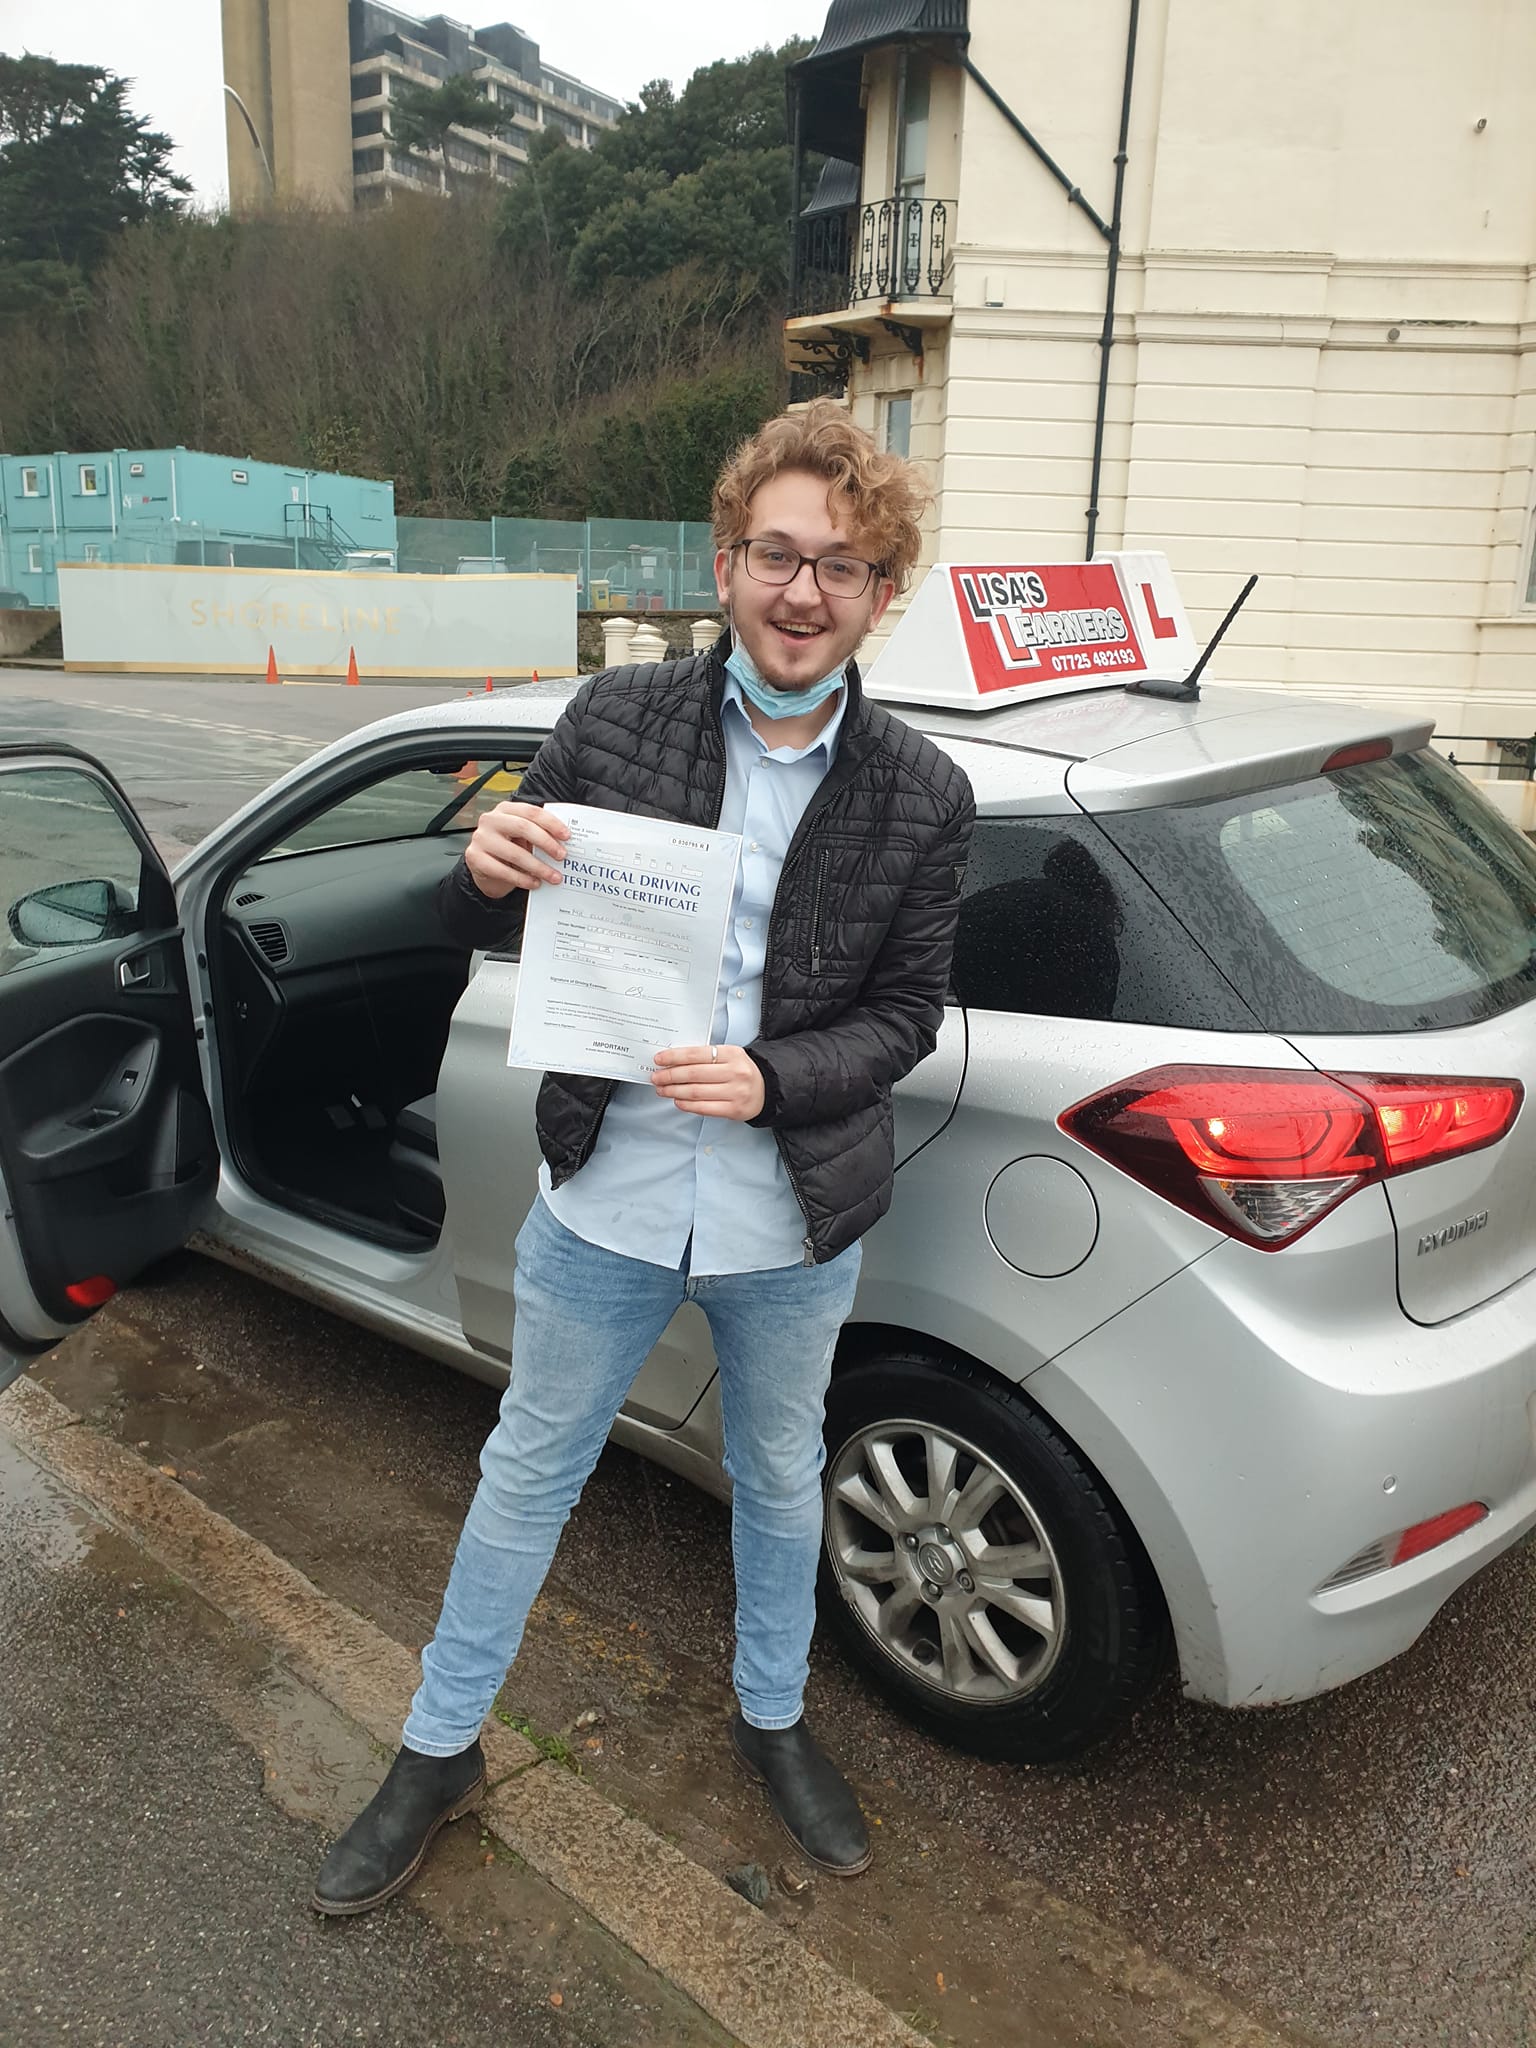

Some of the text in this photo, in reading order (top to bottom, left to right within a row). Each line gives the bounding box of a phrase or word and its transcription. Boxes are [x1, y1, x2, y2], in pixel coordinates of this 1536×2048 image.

[960, 574, 1047, 619] LISA'S
[1141, 583, 1178, 639] L
[190, 598, 401, 635] SHORELINE
[992, 607, 1128, 665] LEARNERS
[1051, 648, 1136, 672] 07725 482193
[563, 859, 702, 897] PRACTICAL DRIVING
[563, 875, 590, 889] TEST
[592, 882, 620, 897] PASS
[624, 888, 699, 913] CERTIFICATE
[592, 1040, 630, 1054] IMPORTANT
